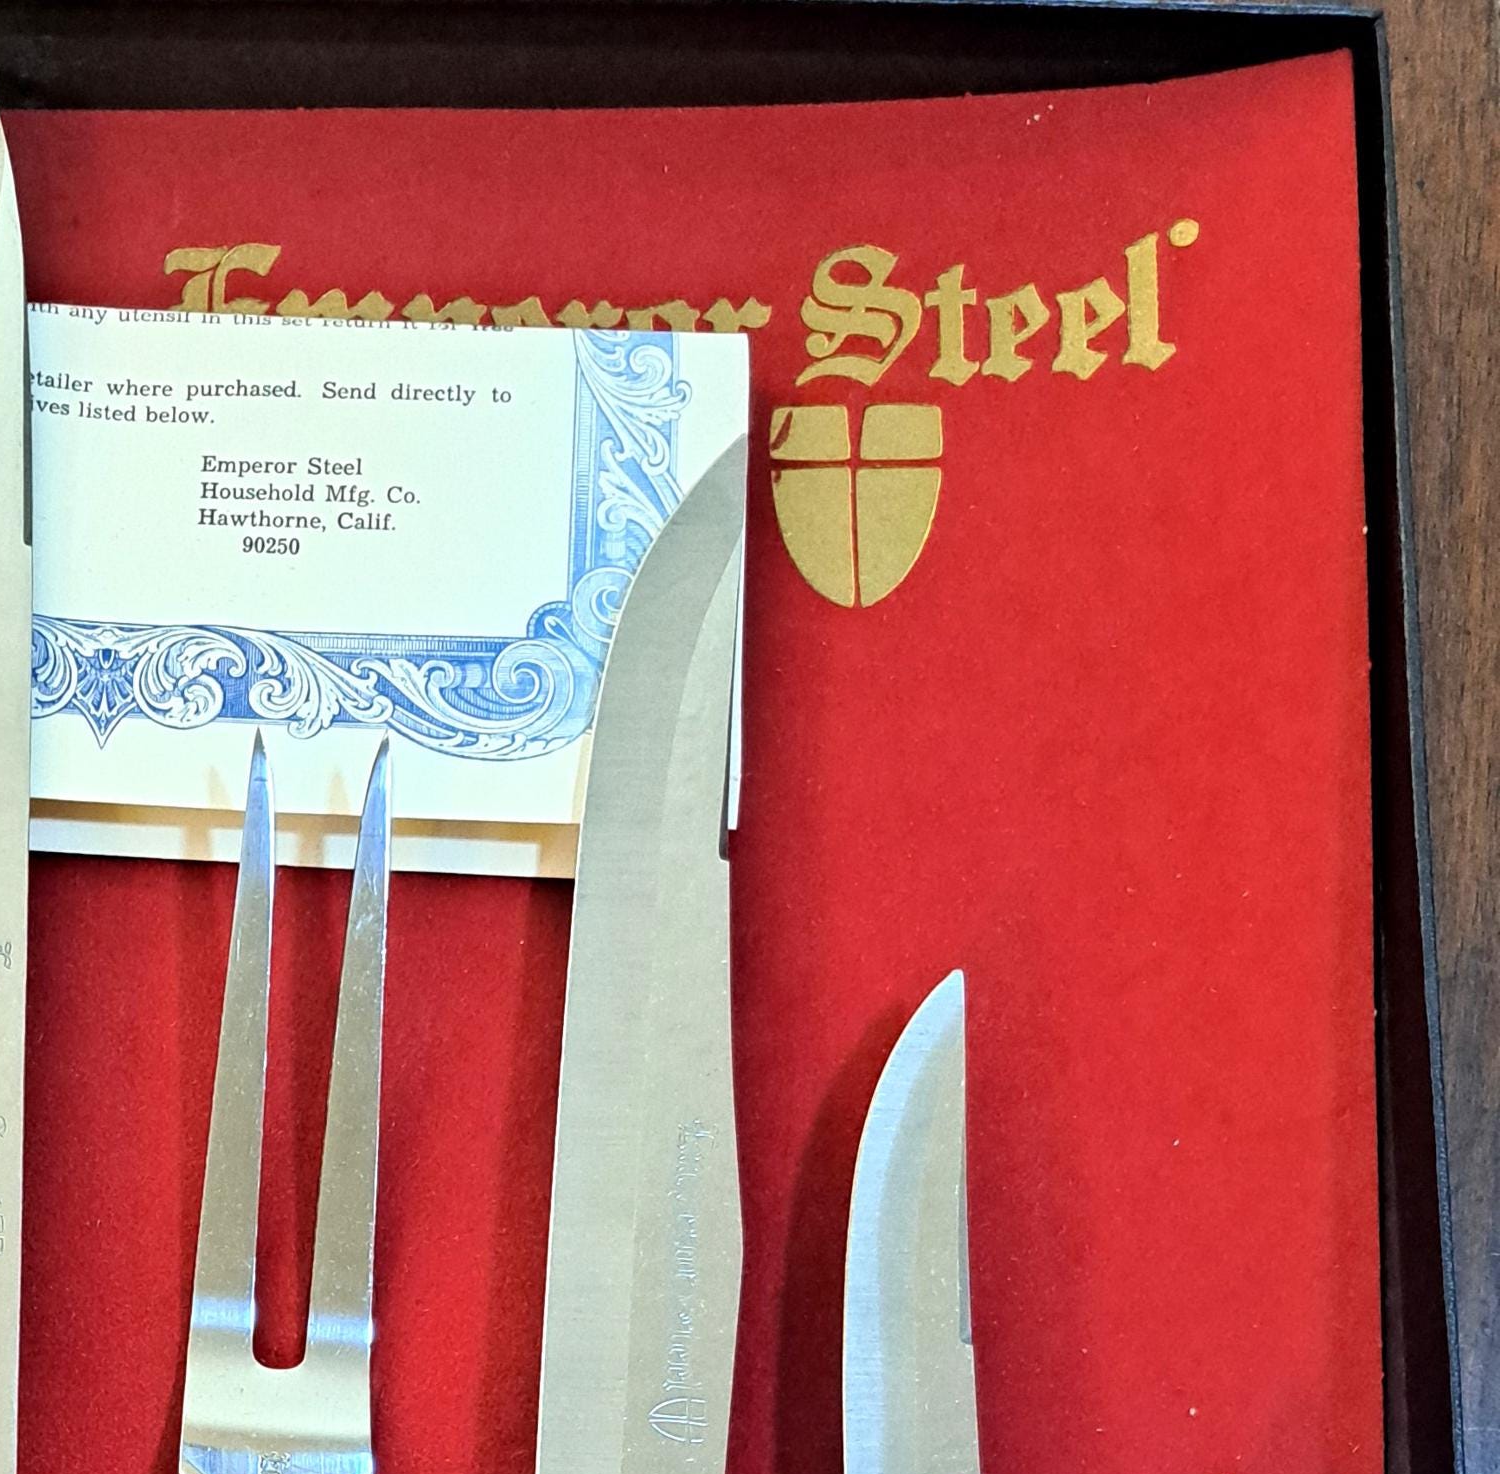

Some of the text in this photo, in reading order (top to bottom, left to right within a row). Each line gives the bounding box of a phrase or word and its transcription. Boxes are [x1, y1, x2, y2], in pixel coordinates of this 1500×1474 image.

[69, 306, 108, 325] any
[795, 232, 1177, 387] Steel
[107, 379, 173, 397] where
[186, 379, 301, 401] purchased.
[322, 381, 376, 400] Send
[391, 383, 476, 406] directly
[492, 387, 512, 403] to
[79, 401, 136, 422] listed
[146, 405, 215, 424] below.
[200, 455, 363, 477] Emperor Steel
[200, 482, 421, 508] Household Mfg. Co.
[198, 508, 396, 533] Hawthorne, Calif.
[242, 536, 300, 555] 90250
